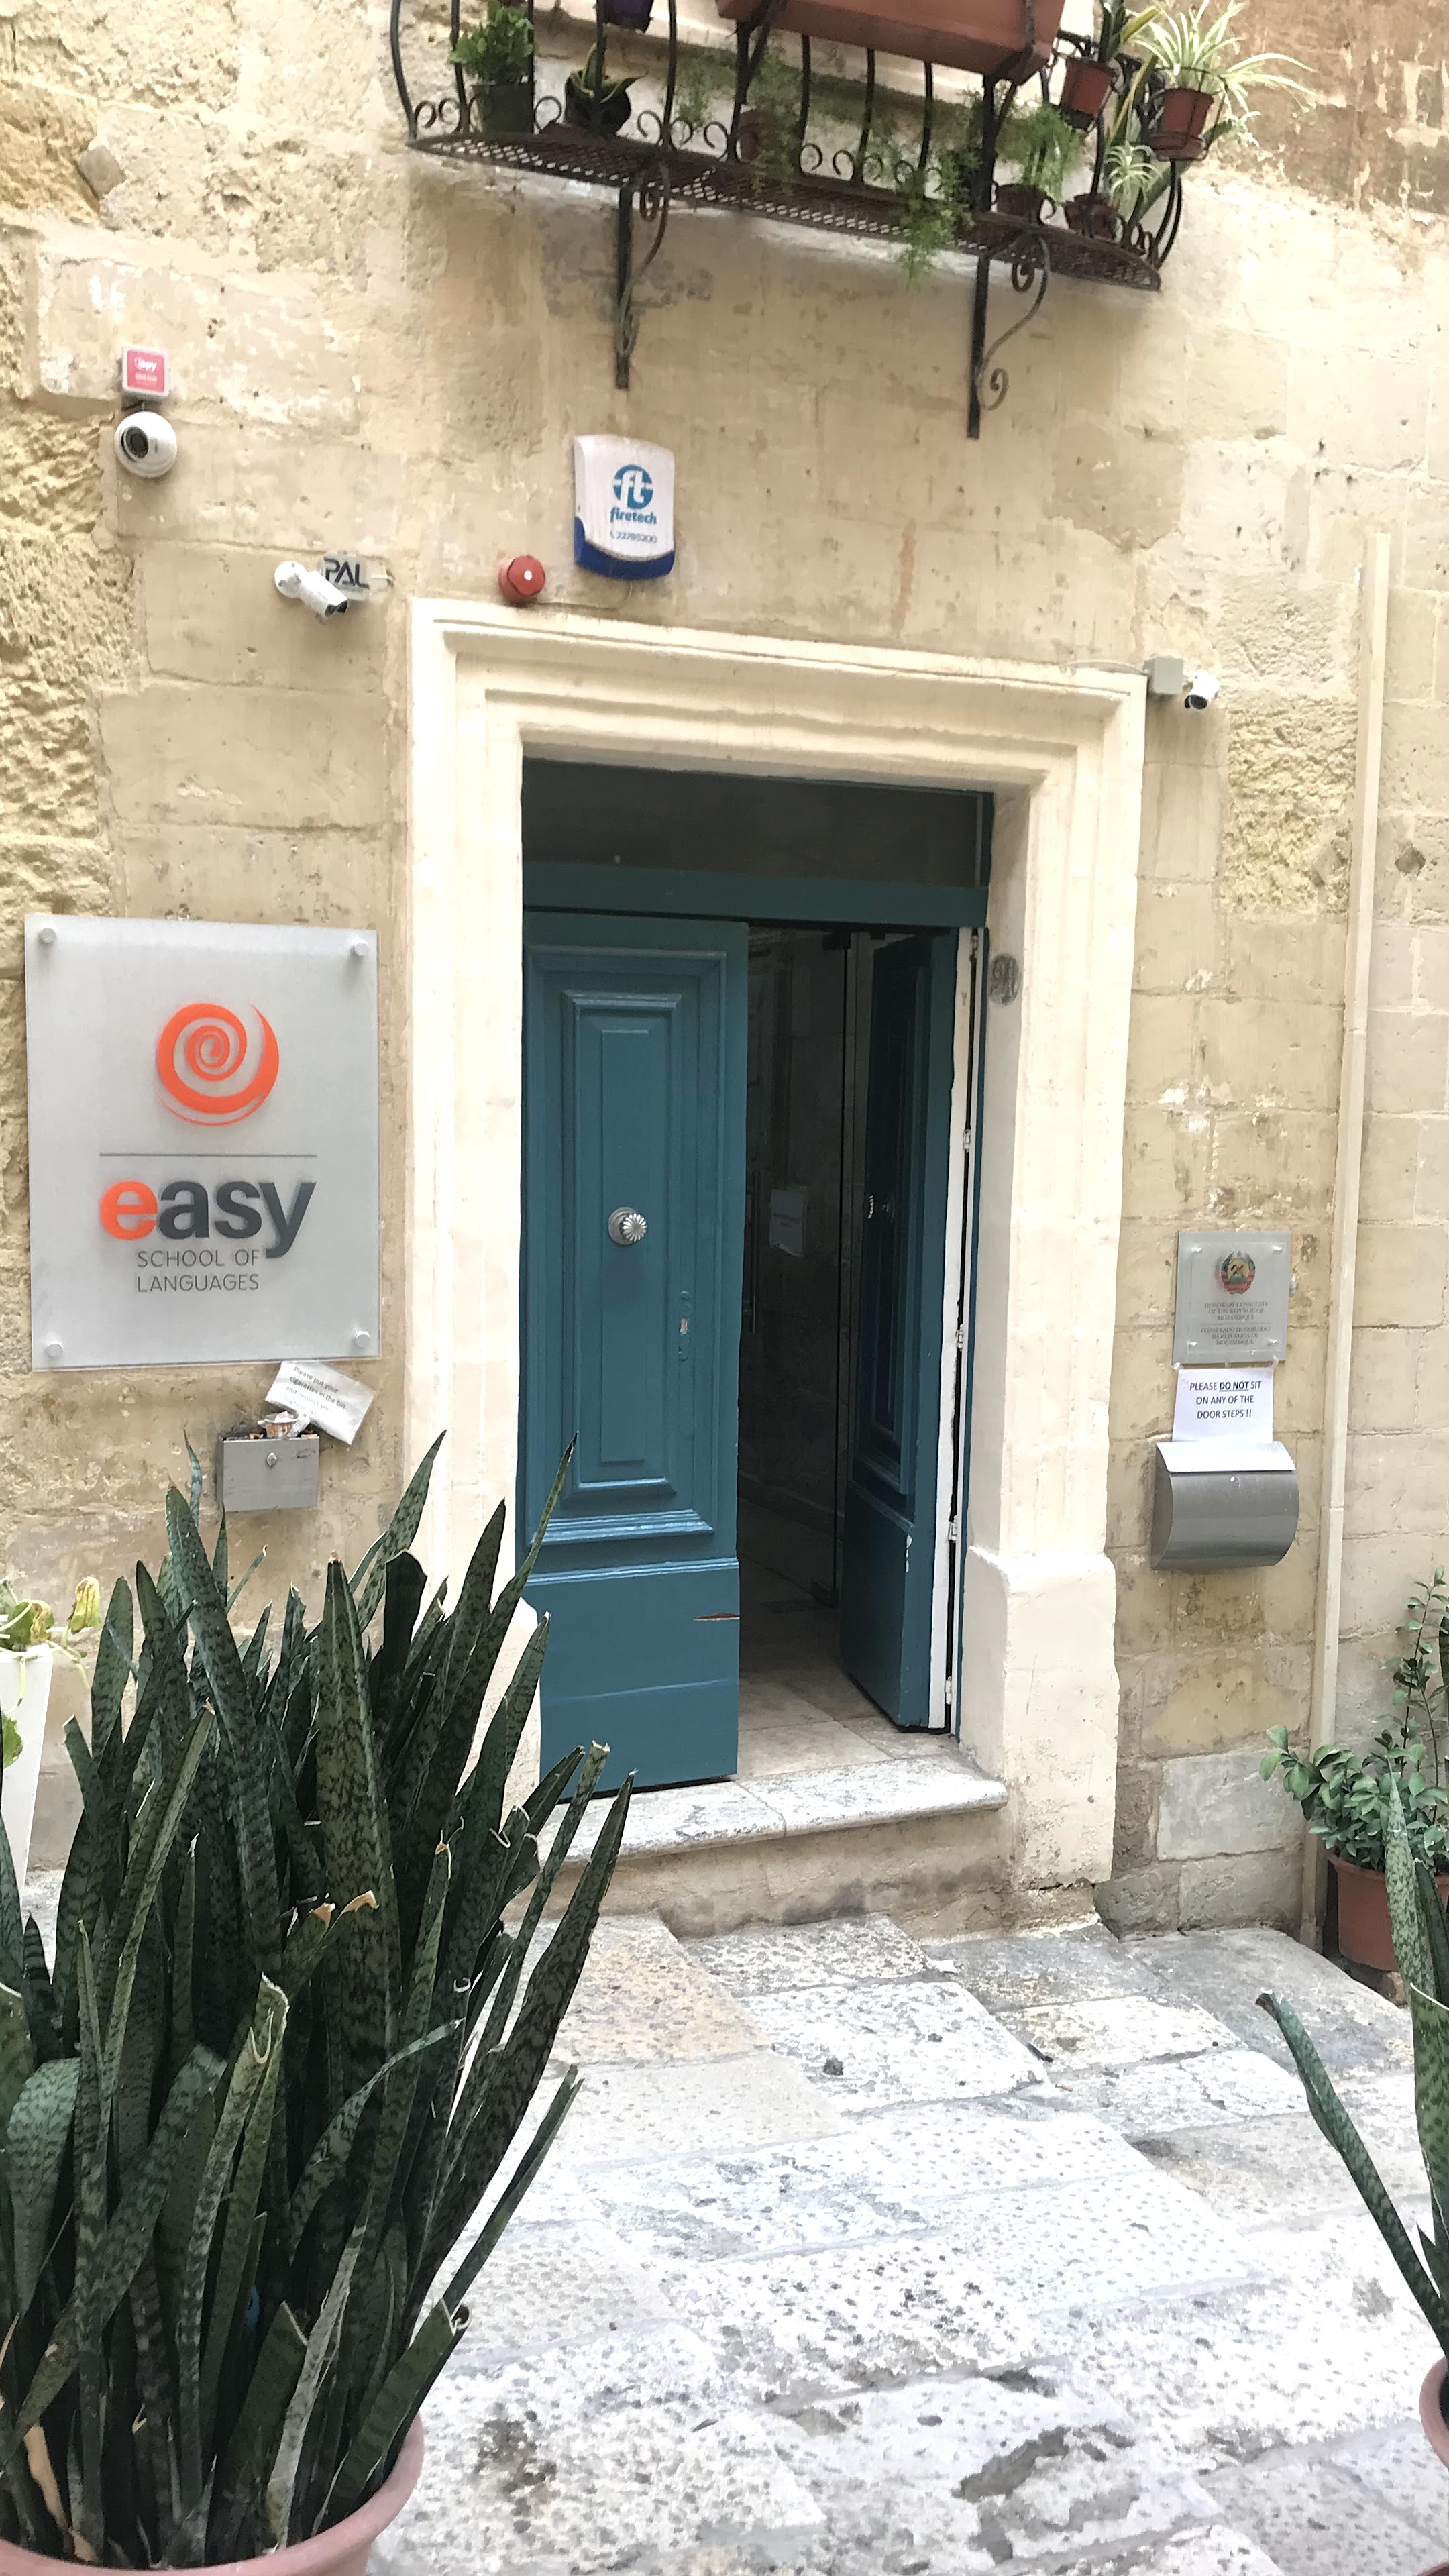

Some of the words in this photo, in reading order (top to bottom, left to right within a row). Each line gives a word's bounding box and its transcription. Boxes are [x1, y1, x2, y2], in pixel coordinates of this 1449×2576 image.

[610, 506, 657, 524] firetech
[323, 557, 370, 590] PAL
[101, 1180, 317, 1259] easy
[138, 1250, 225, 1267] SCHOOL
[235, 1248, 260, 1266] OF
[138, 1274, 260, 1293] LANGUAGES
[294, 1366, 313, 1380] Please
[313, 1377, 324, 1386] put
[324, 1383, 339, 1393] your
[1190, 1382, 1218, 1391] PLEASE
[1219, 1381, 1231, 1390] DO
[1233, 1381, 1249, 1389] NOT
[1250, 1381, 1262, 1389] SIT
[285, 1386, 298, 1395] and
[289, 1376, 319, 1394] cigarettes
[325, 1395, 336, 1403] the
[336, 1399, 346, 1409] bin
[1196, 1396, 1208, 1405] ON
[1210, 1395, 1226, 1404] ANY
[1228, 1395, 1238, 1404] OF
[1240, 1395, 1254, 1403] THE
[1197, 1410, 1220, 1419] DOOR
[1222, 1409, 1244, 1418] STEPS
